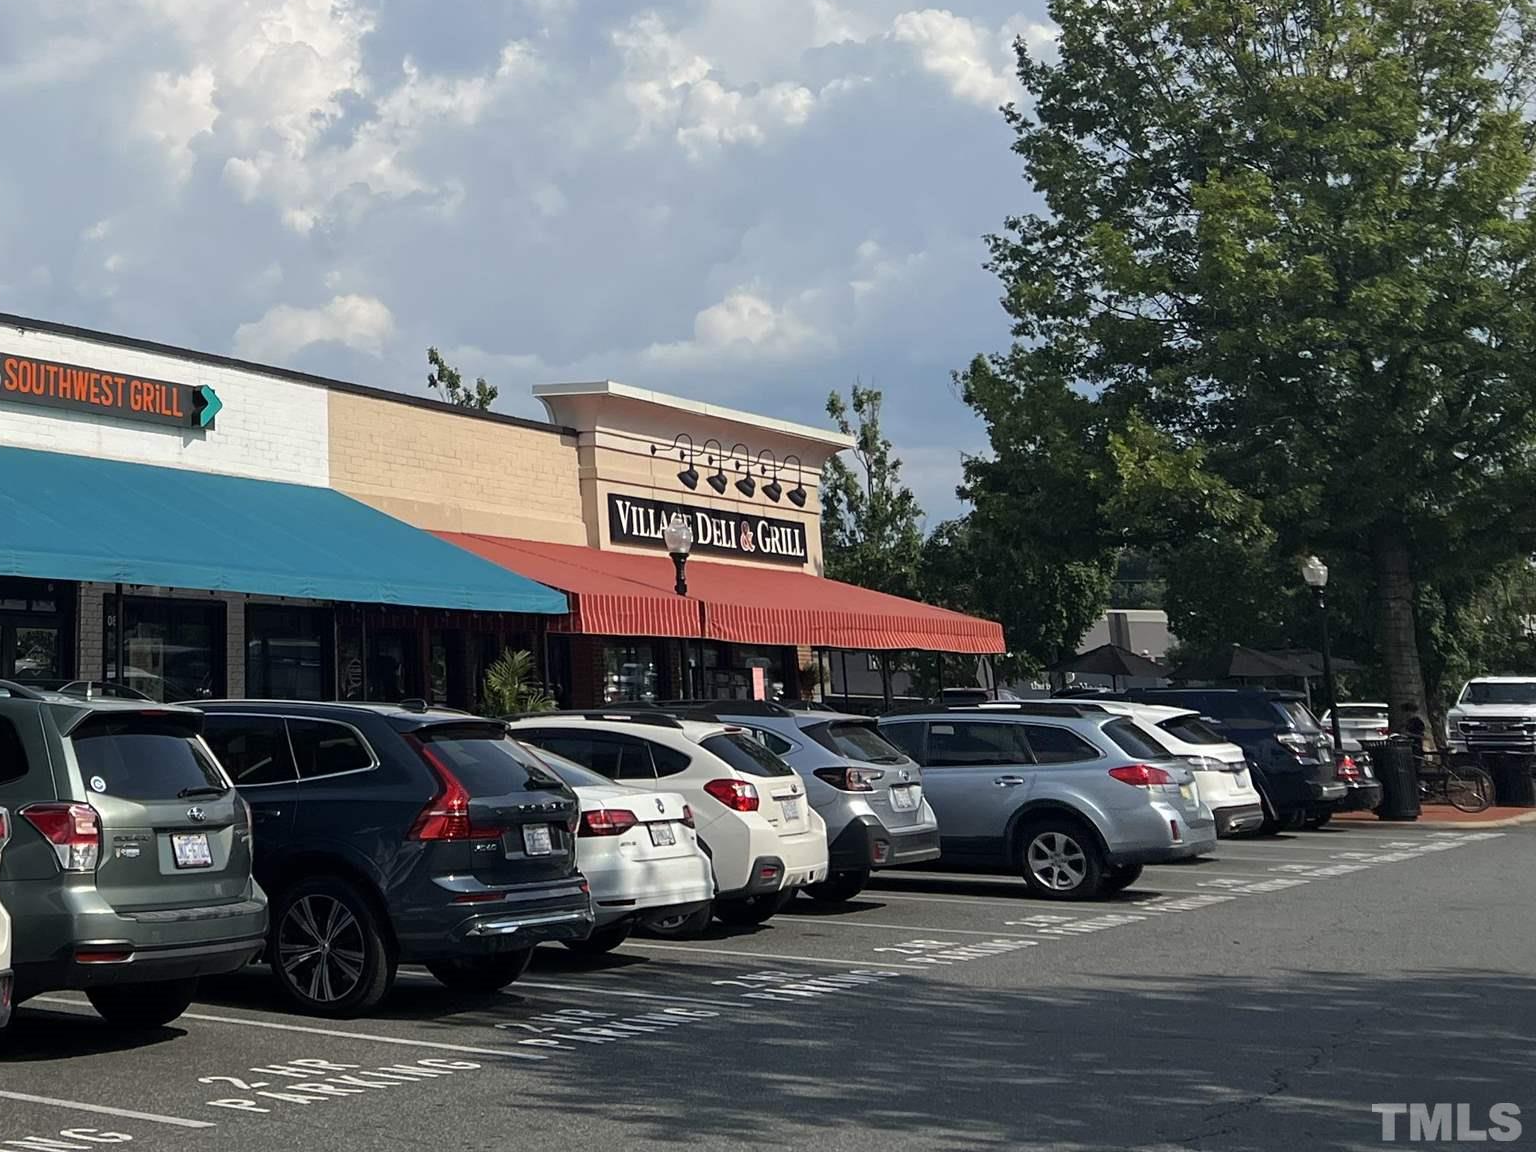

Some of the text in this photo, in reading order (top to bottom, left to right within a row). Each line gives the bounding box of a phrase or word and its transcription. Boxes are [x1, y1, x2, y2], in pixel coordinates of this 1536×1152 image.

[3, 358, 127, 407] SOUTHWEST
[696, 512, 737, 548] DELI
[740, 521, 755, 552] &
[757, 521, 805, 557] GRILL
[517, 1008, 720, 1050] PARKING
[205, 1059, 482, 1112] PARKING
[249, 1059, 360, 1078] HR
